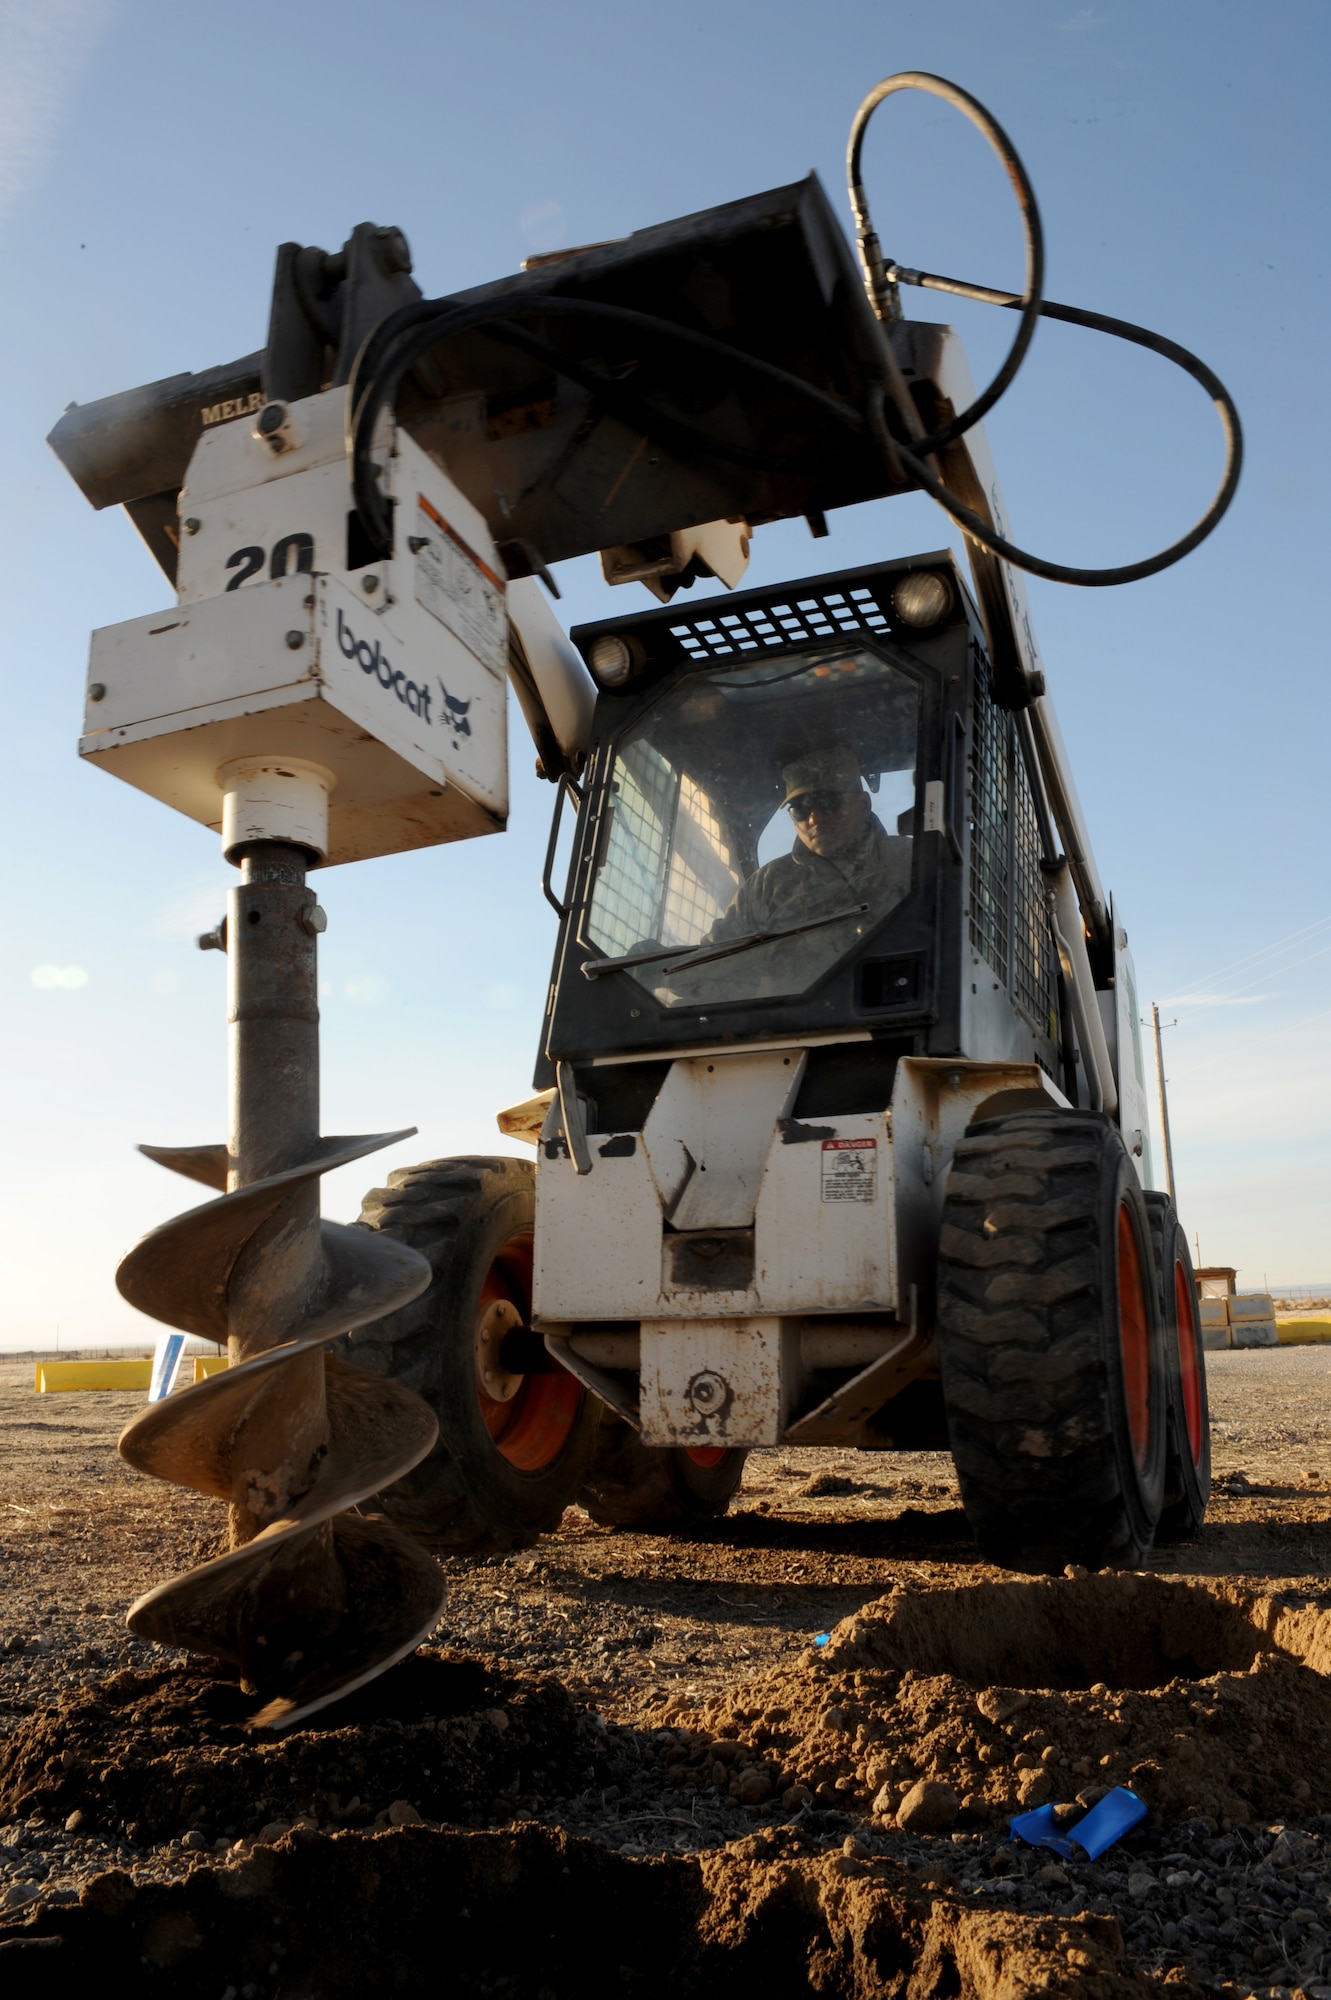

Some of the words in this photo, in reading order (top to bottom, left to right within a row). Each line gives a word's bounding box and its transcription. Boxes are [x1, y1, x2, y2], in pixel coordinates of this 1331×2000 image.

[201, 393, 268, 425] MELR
[225, 533, 314, 592] 20
[337, 607, 432, 726] bobcat
[838, 1141, 873, 1149] DANGER
